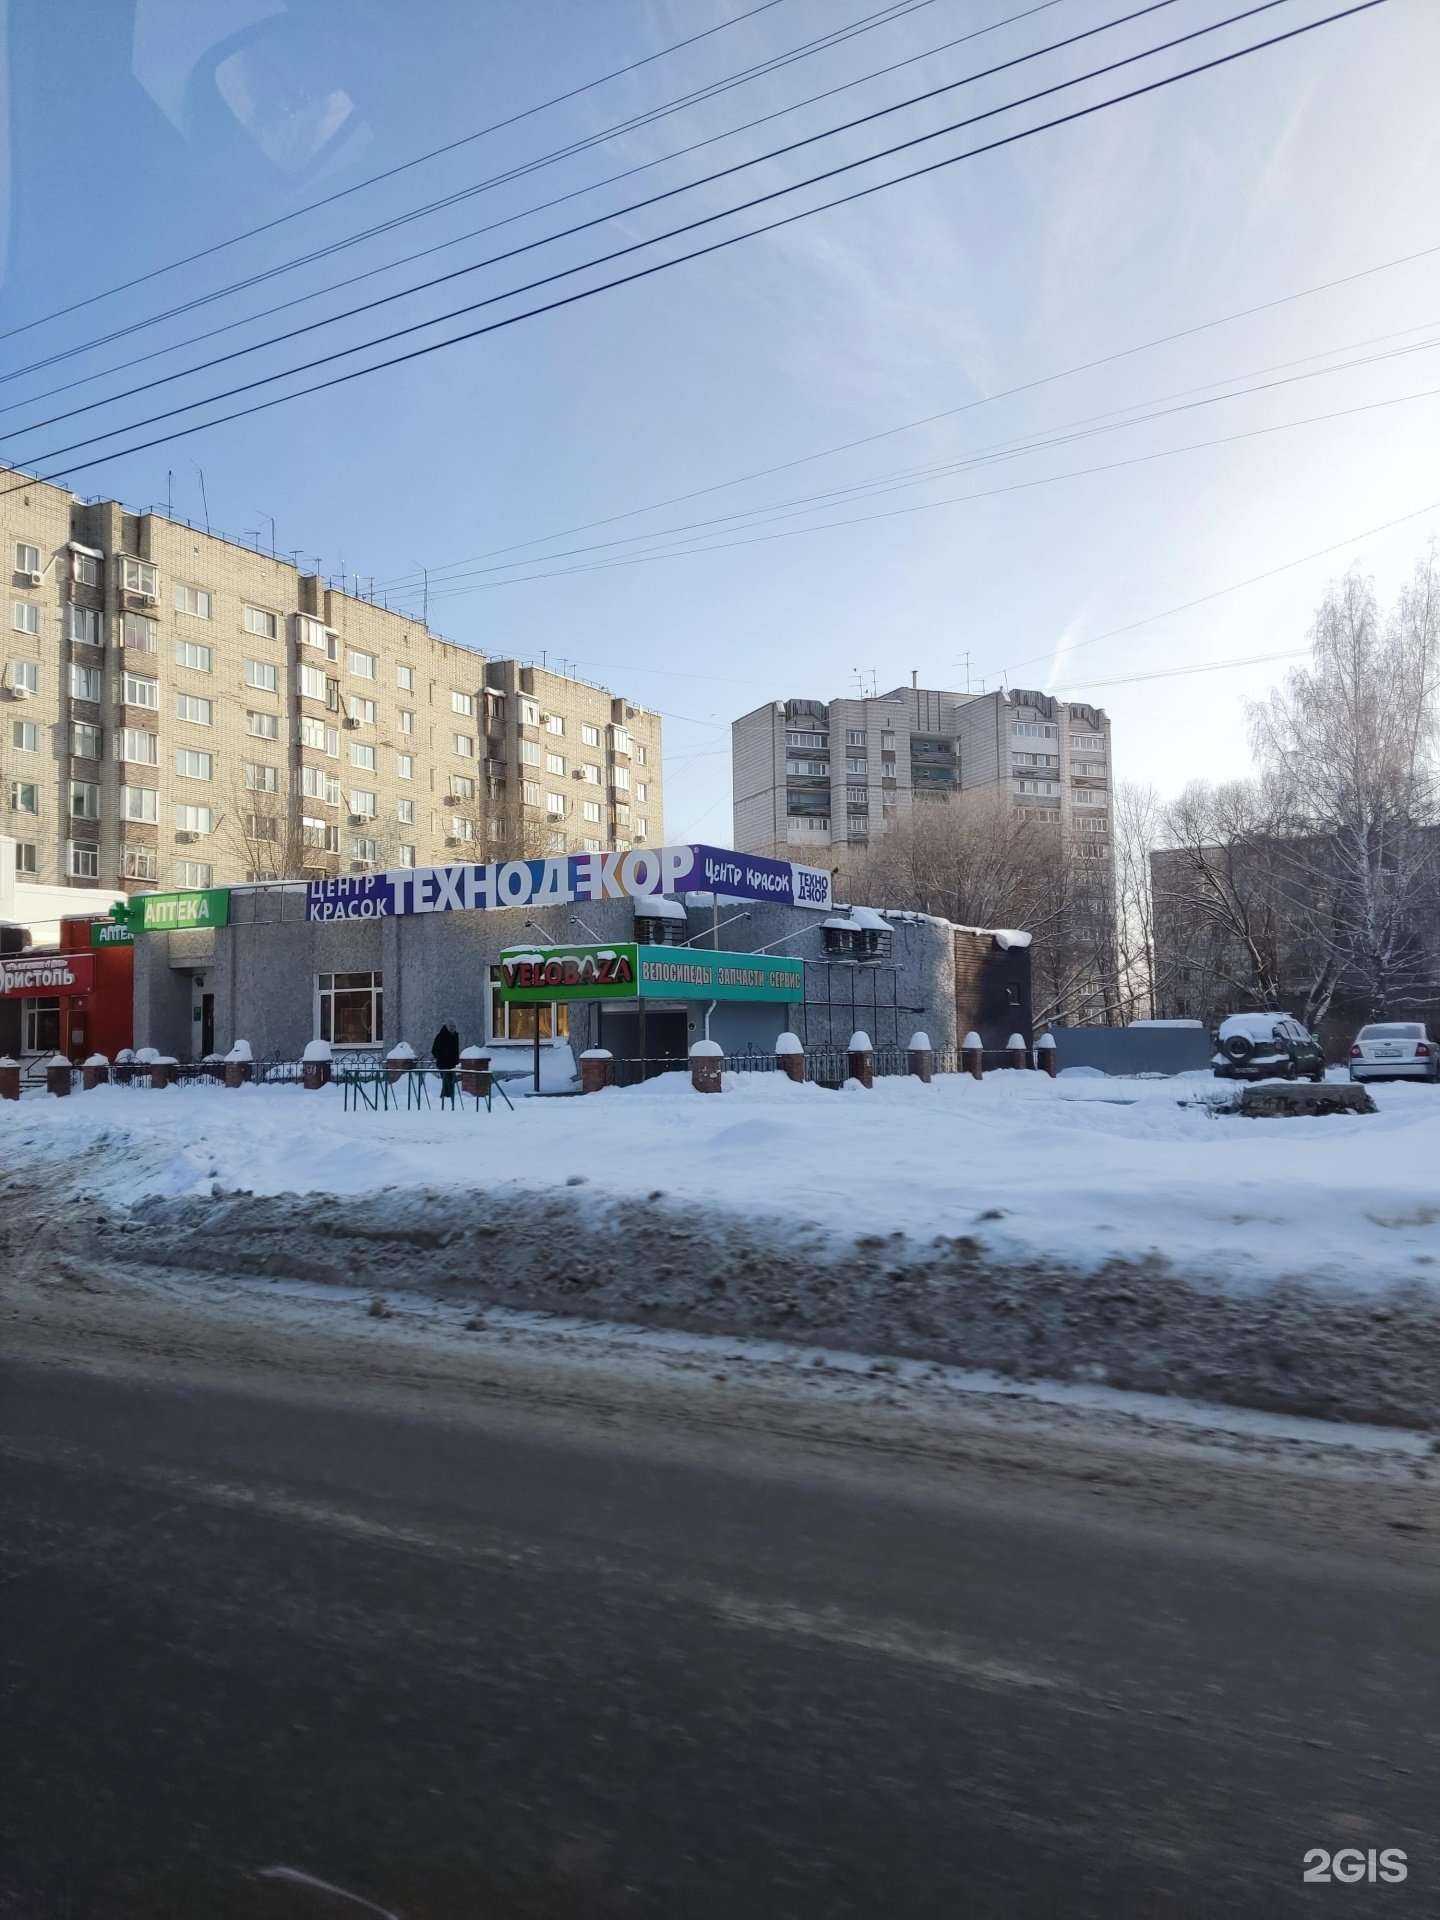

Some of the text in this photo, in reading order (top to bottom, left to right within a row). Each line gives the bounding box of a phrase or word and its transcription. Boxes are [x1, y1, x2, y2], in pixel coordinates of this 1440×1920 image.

[311, 875, 376, 902] ЦЕНТР
[798, 871, 829, 890] ТЕХНО
[144, 898, 210, 923] АПТЕКА
[310, 897, 388, 922] КРАСОК
[501, 955, 632, 988] VELOBAZA
[642, 961, 801, 989] ВЕЛОСИПЕДЫ ЗАПЧАСТИ СЕРВИС
